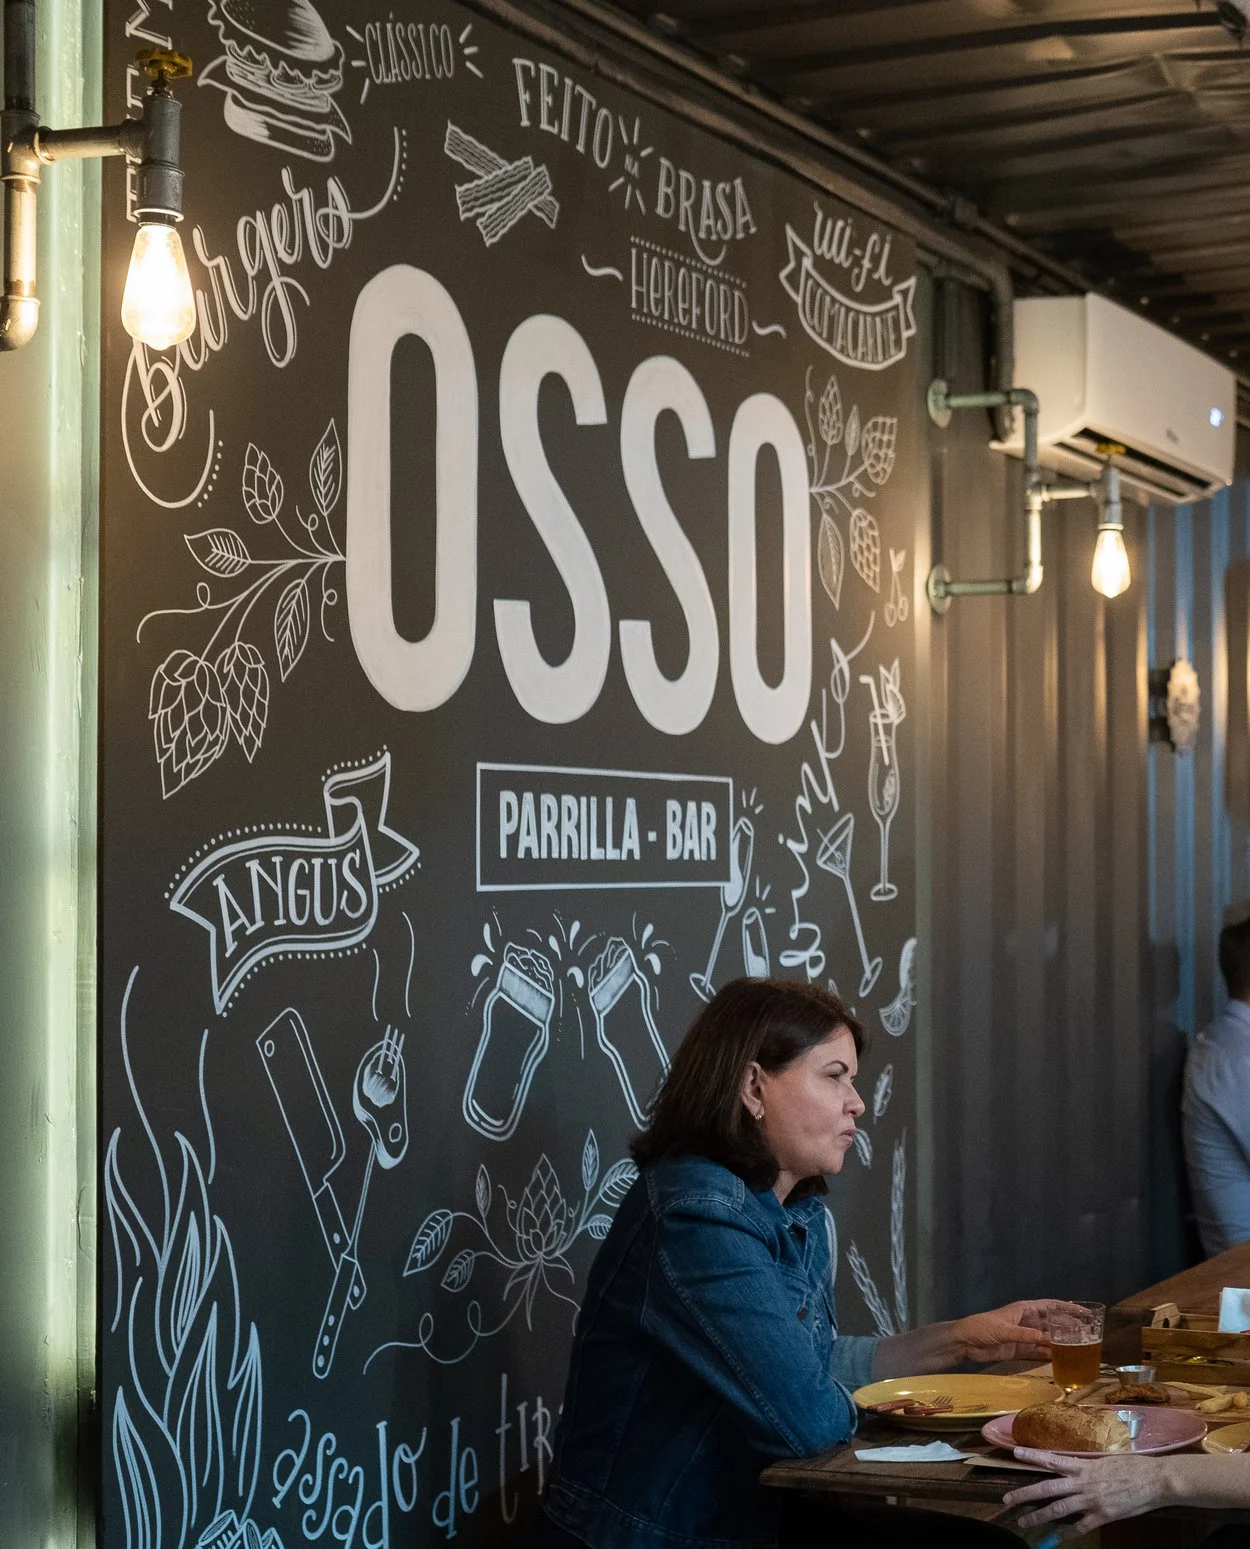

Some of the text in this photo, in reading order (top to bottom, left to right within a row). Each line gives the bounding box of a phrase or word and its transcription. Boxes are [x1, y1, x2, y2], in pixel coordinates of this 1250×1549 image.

[364, 13, 455, 86] CLÁSSICO
[513, 57, 615, 169] FEITO
[655, 156, 758, 266] BRASA
[346, 263, 813, 745] OSSO
[500, 790, 641, 861] PARRILLA
[666, 799, 717, 862] BAR
[212, 848, 368, 958] ANGUS
[432, 1416, 479, 1540] de
